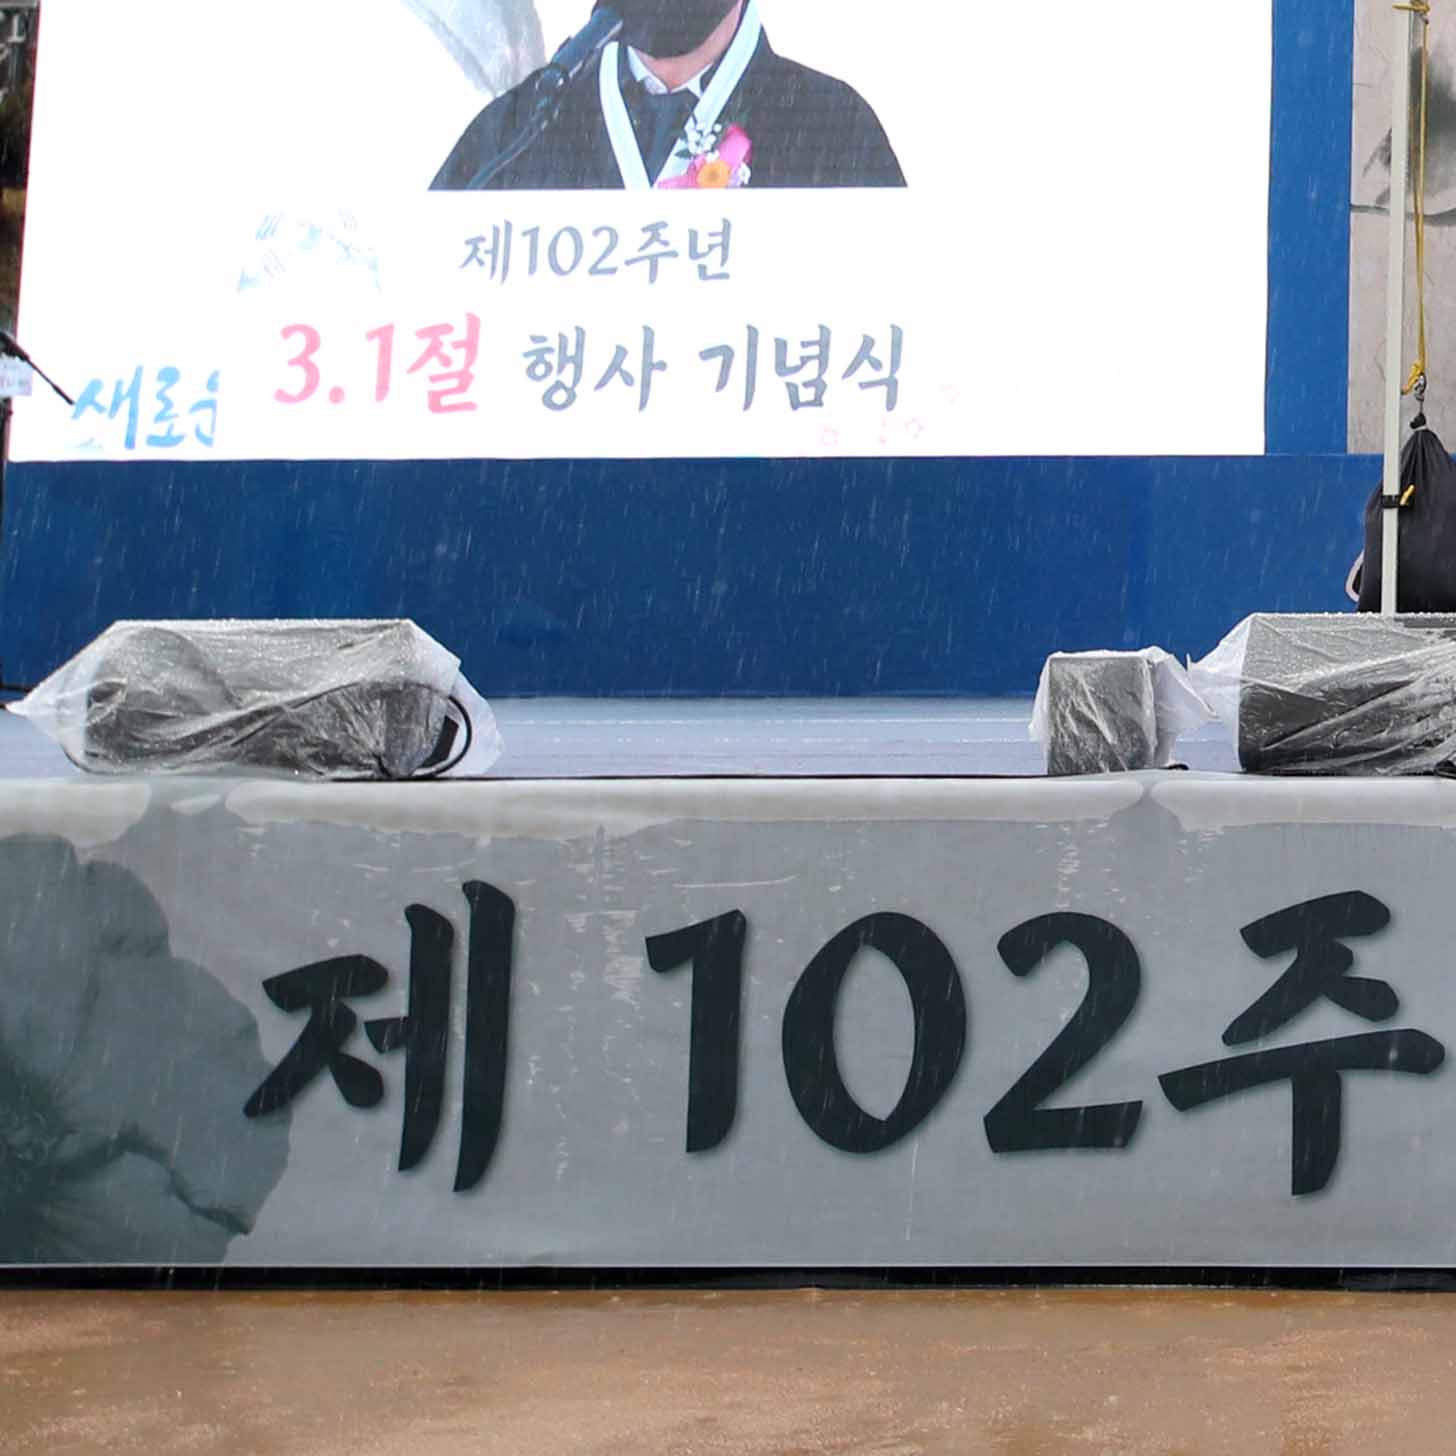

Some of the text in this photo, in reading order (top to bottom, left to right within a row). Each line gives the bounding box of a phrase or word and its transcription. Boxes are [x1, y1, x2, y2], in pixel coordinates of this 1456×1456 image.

[460, 218, 733, 285] 제102주년
[272, 310, 904, 415] 3.1절 행사 기념식
[243, 879, 517, 1193] 제
